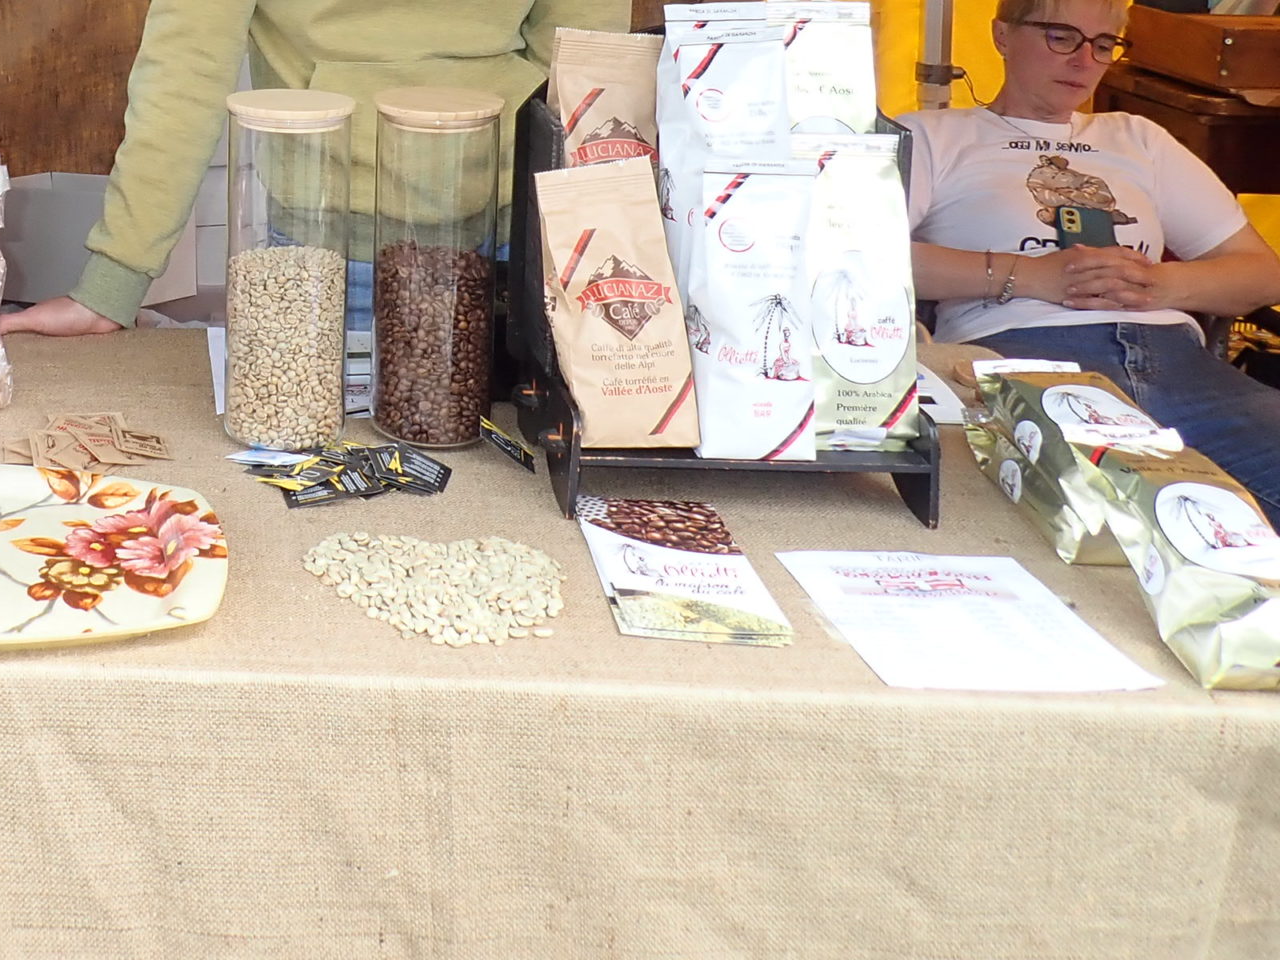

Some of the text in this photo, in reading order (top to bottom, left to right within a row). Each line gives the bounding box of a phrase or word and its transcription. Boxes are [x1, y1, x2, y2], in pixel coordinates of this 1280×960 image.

[587, 283, 659, 301] LUCIANAZ
[609, 302, 640, 320] Café
[614, 360, 656, 371] delle Alpi
[602, 376, 623, 387] Café
[659, 375, 669, 383] en
[601, 383, 673, 396] Vallée d'Aoste
[836, 390, 892, 400] 100% Arabica
[836, 403, 878, 413] Première
[836, 416, 867, 427] qualité
